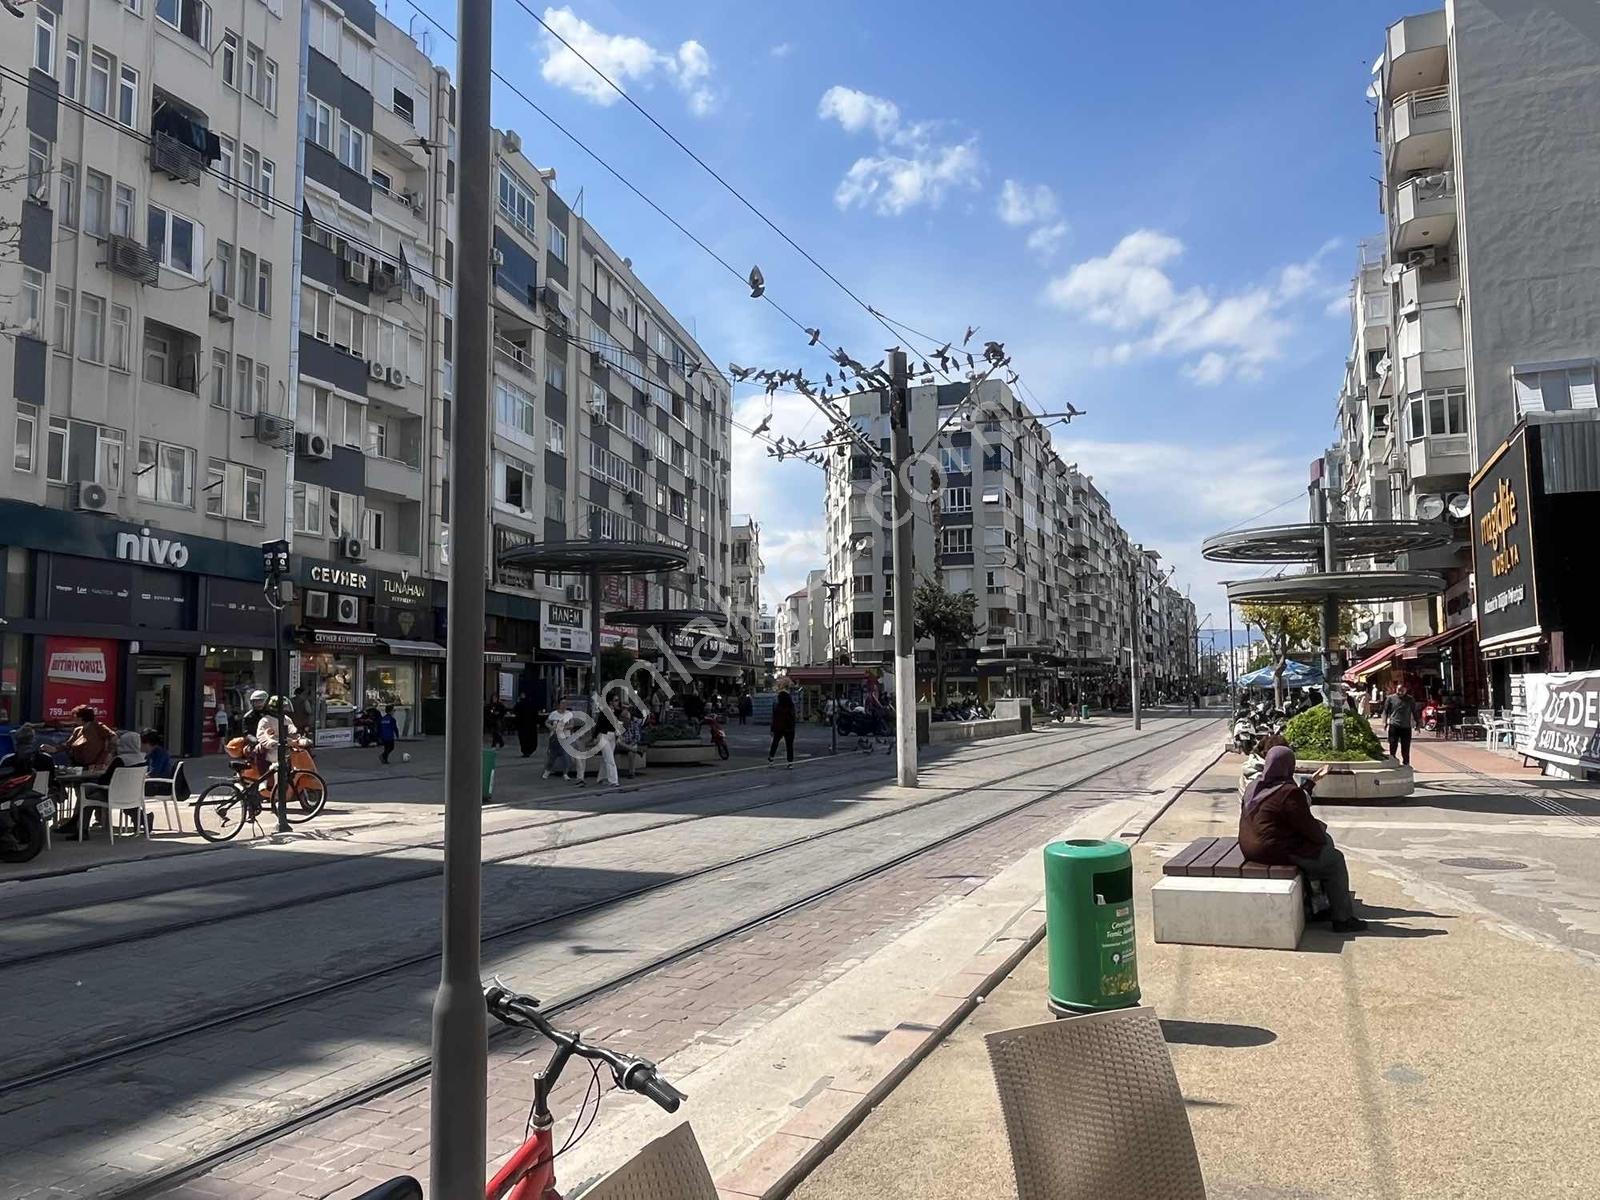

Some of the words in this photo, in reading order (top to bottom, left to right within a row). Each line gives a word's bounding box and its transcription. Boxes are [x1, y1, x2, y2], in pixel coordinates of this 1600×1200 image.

[116, 527, 189, 568] nivo
[311, 566, 367, 589] CEVHER
[383, 579, 425, 597] TUNAHAN
